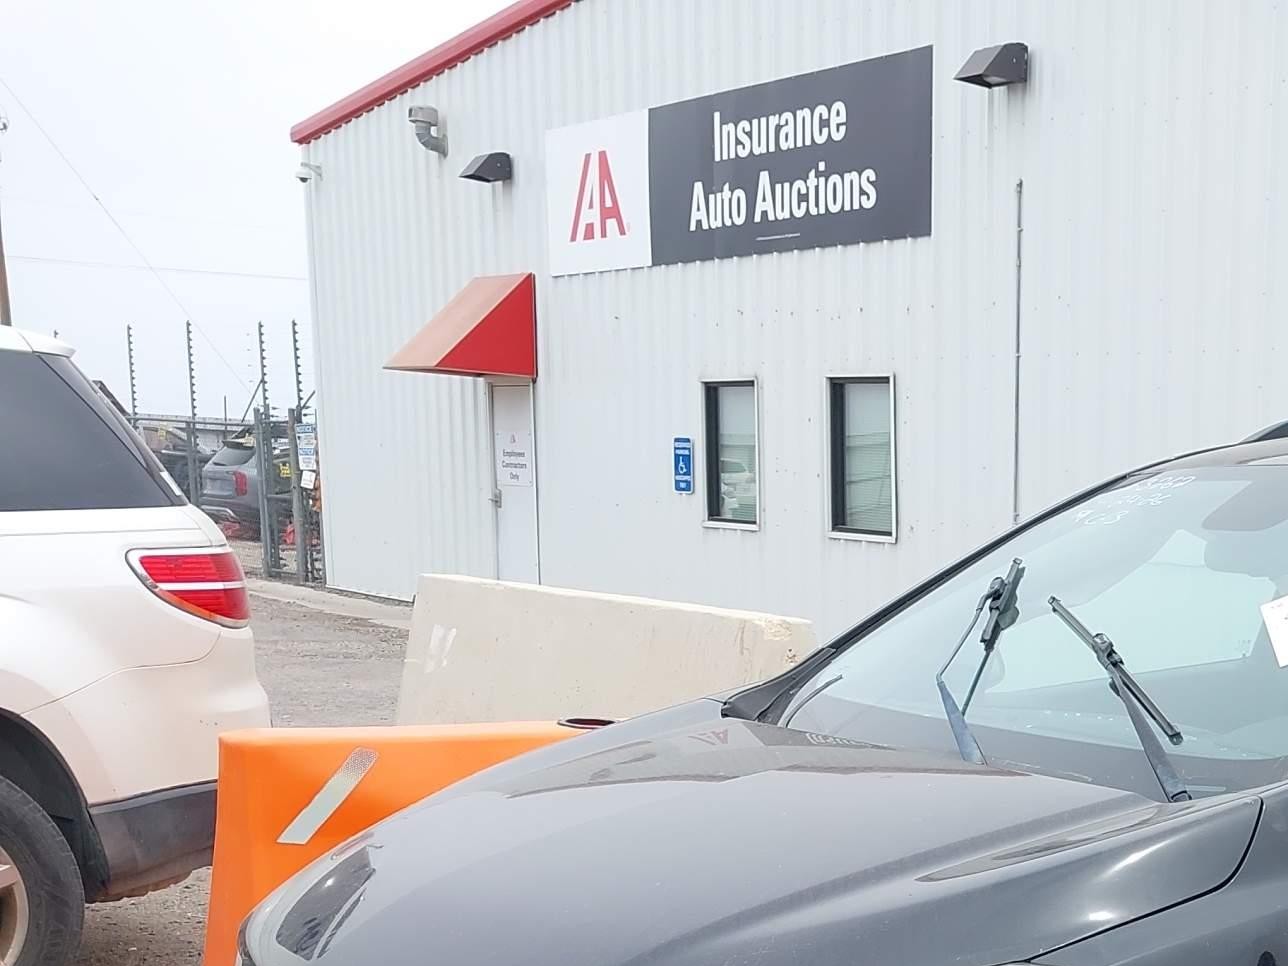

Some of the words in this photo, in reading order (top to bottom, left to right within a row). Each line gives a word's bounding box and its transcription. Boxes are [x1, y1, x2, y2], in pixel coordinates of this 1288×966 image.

[713, 100, 847, 162] Insurance
[689, 181, 747, 232] Auto
[753, 161, 877, 223] Auctions
